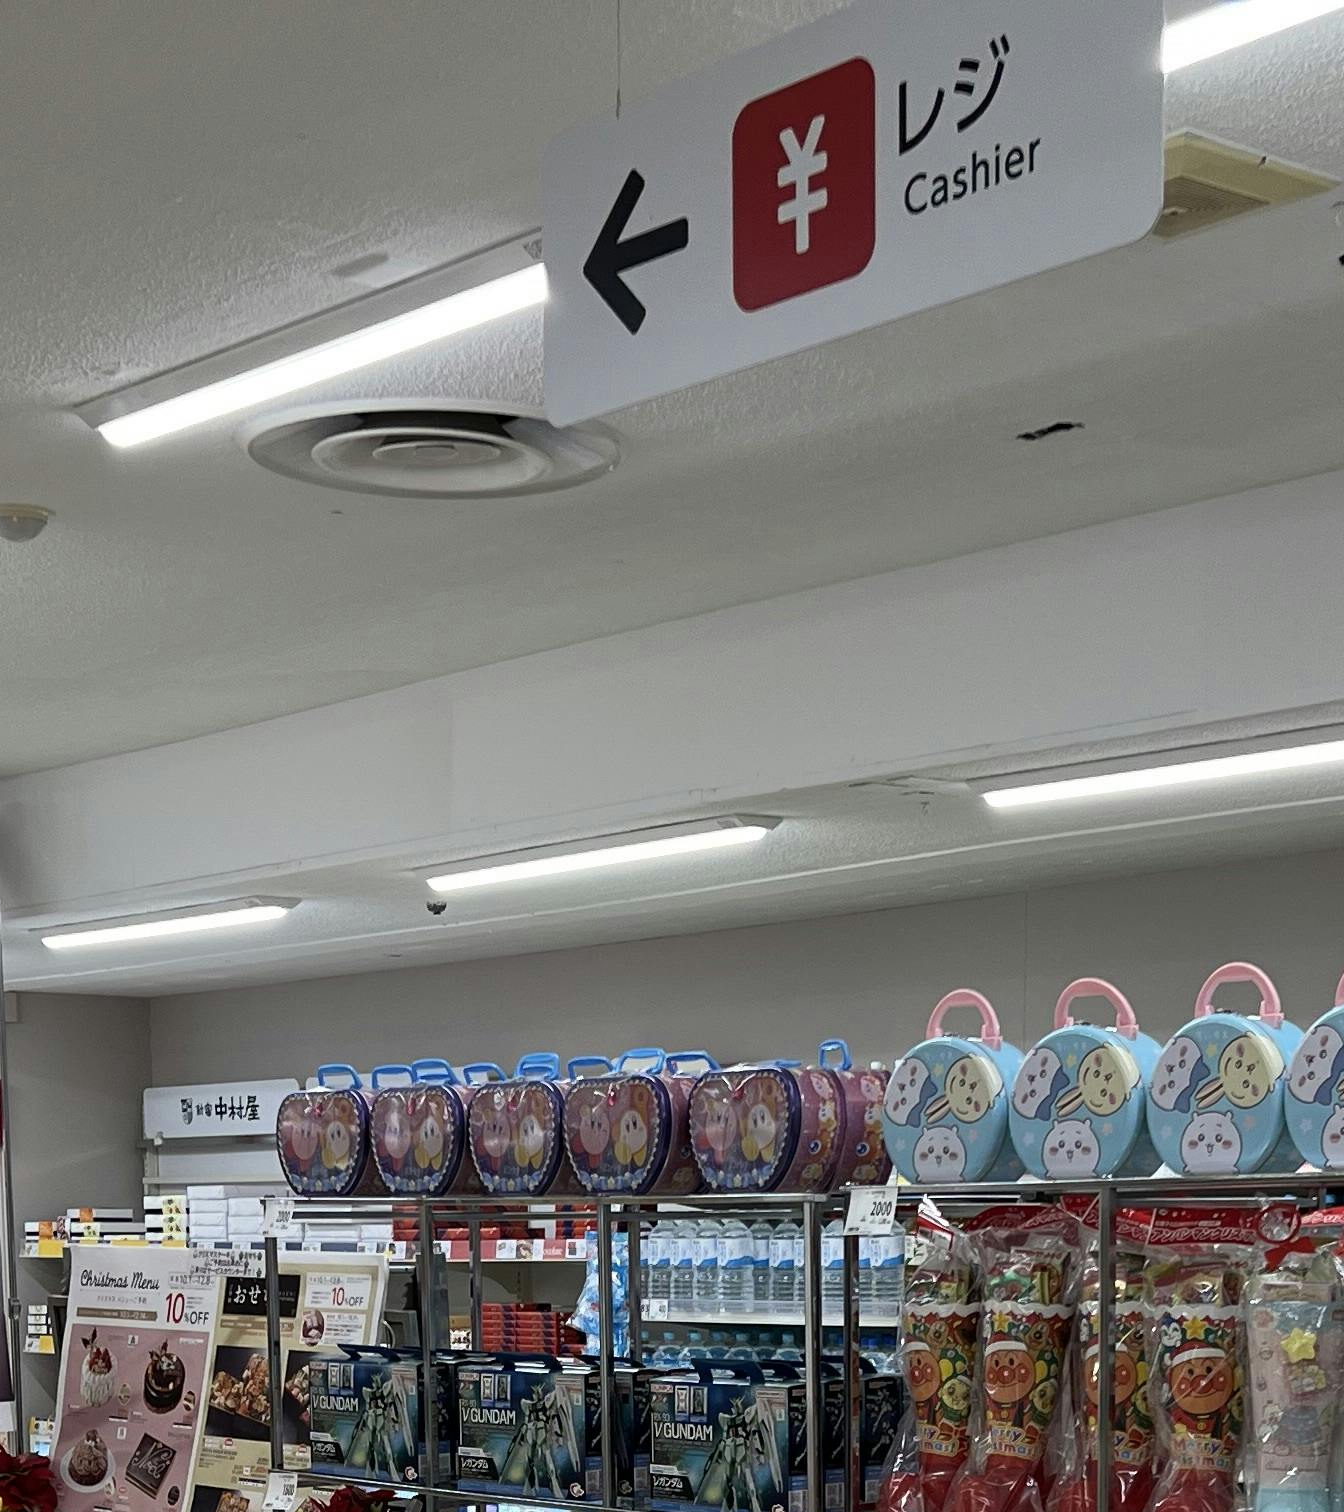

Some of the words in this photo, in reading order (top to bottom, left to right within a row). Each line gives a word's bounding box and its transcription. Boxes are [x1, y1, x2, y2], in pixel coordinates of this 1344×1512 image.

[898, 33, 1010, 156] レジ
[904, 137, 1042, 215] Cashier
[214, 1095, 260, 1121] 中村屋
[870, 1201, 893, 1216] 2000
[81, 1269, 128, 1288] Christmas
[128, 1272, 160, 1290] Menu
[234, 1284, 268, 1304] おせ
[319, 1396, 359, 1412] GUNDAM
[471, 1407, 516, 1425] GUNDAM
[663, 1422, 713, 1441] GUNDAM
